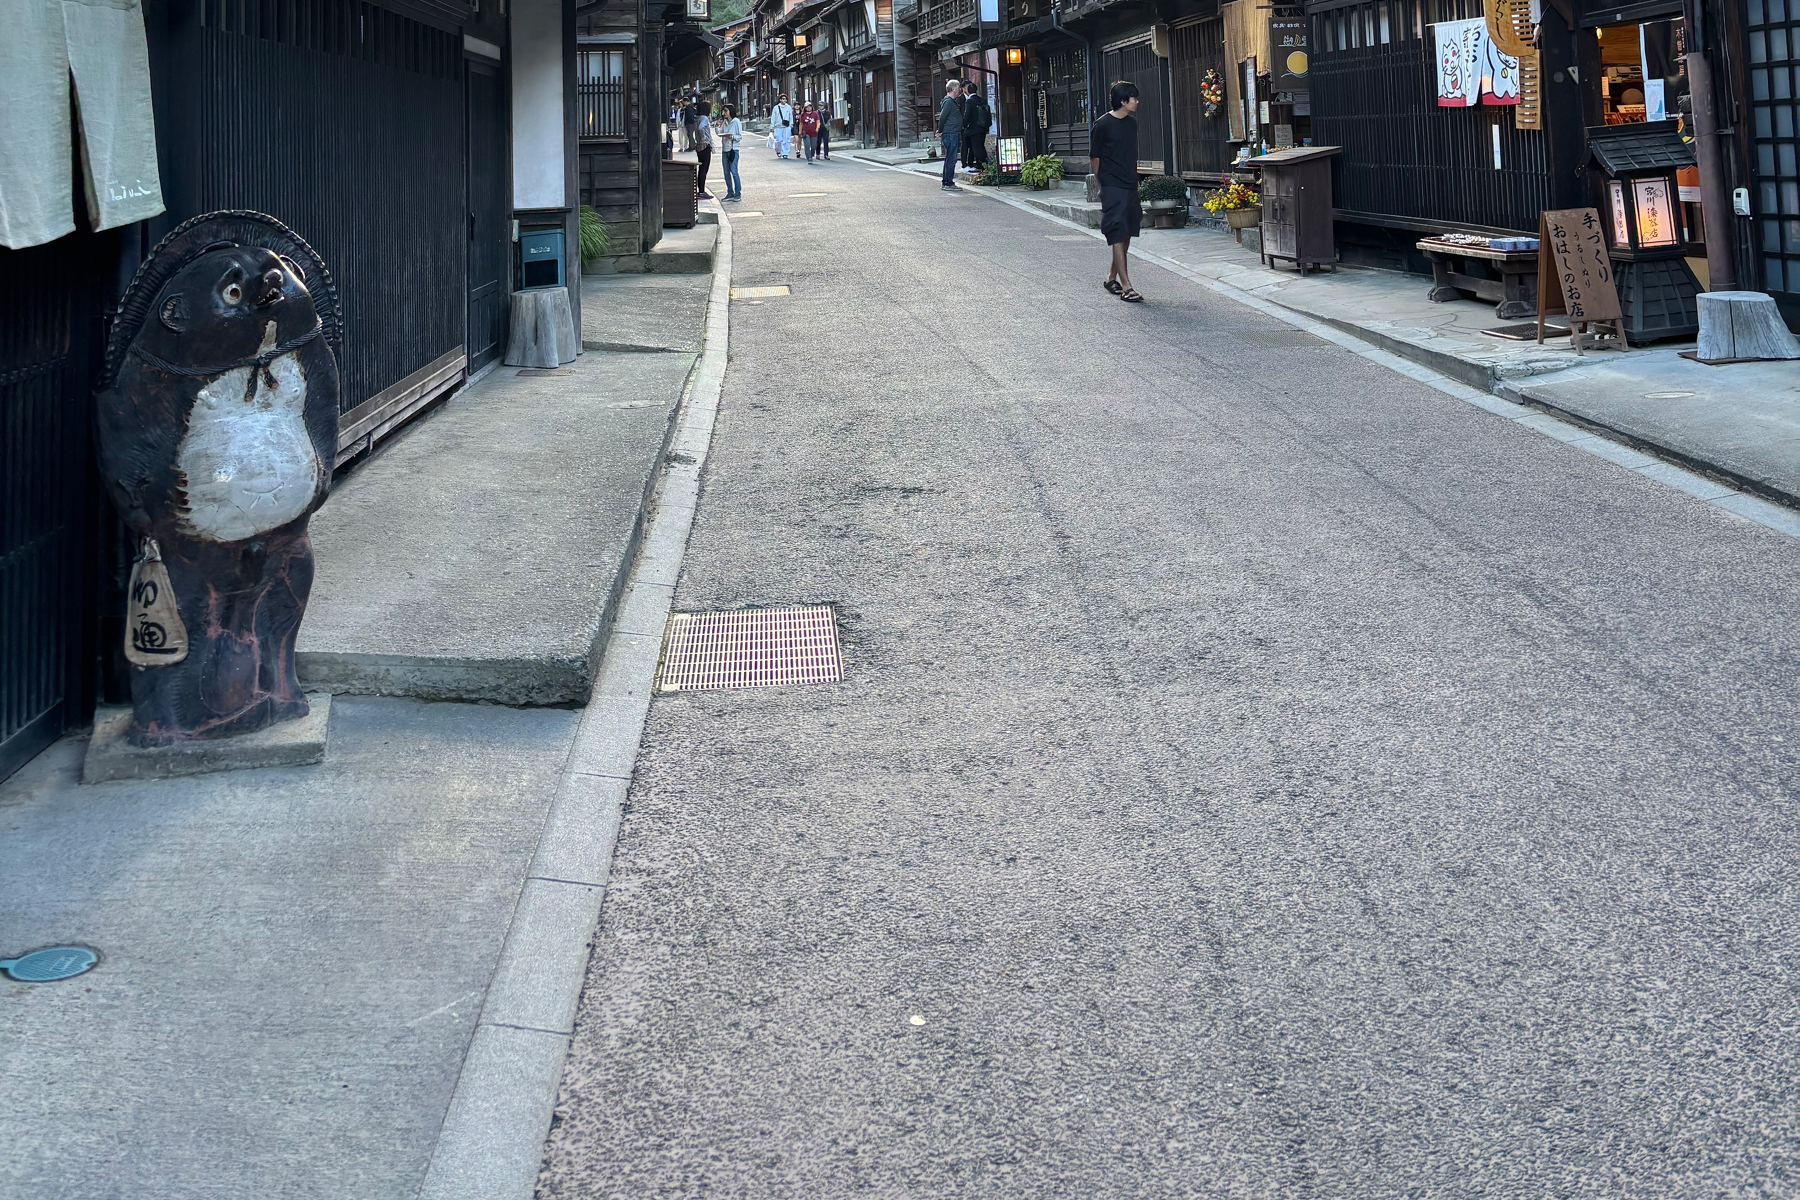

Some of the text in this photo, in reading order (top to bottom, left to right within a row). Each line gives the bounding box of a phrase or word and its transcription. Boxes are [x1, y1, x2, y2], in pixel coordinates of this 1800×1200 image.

[1645, 186, 1659, 240] 宮川漆器店
[1553, 223, 1585, 317] おはしのお店
[1573, 232, 1591, 289] うるしぬり
[1582, 212, 1609, 283] 手づくり
